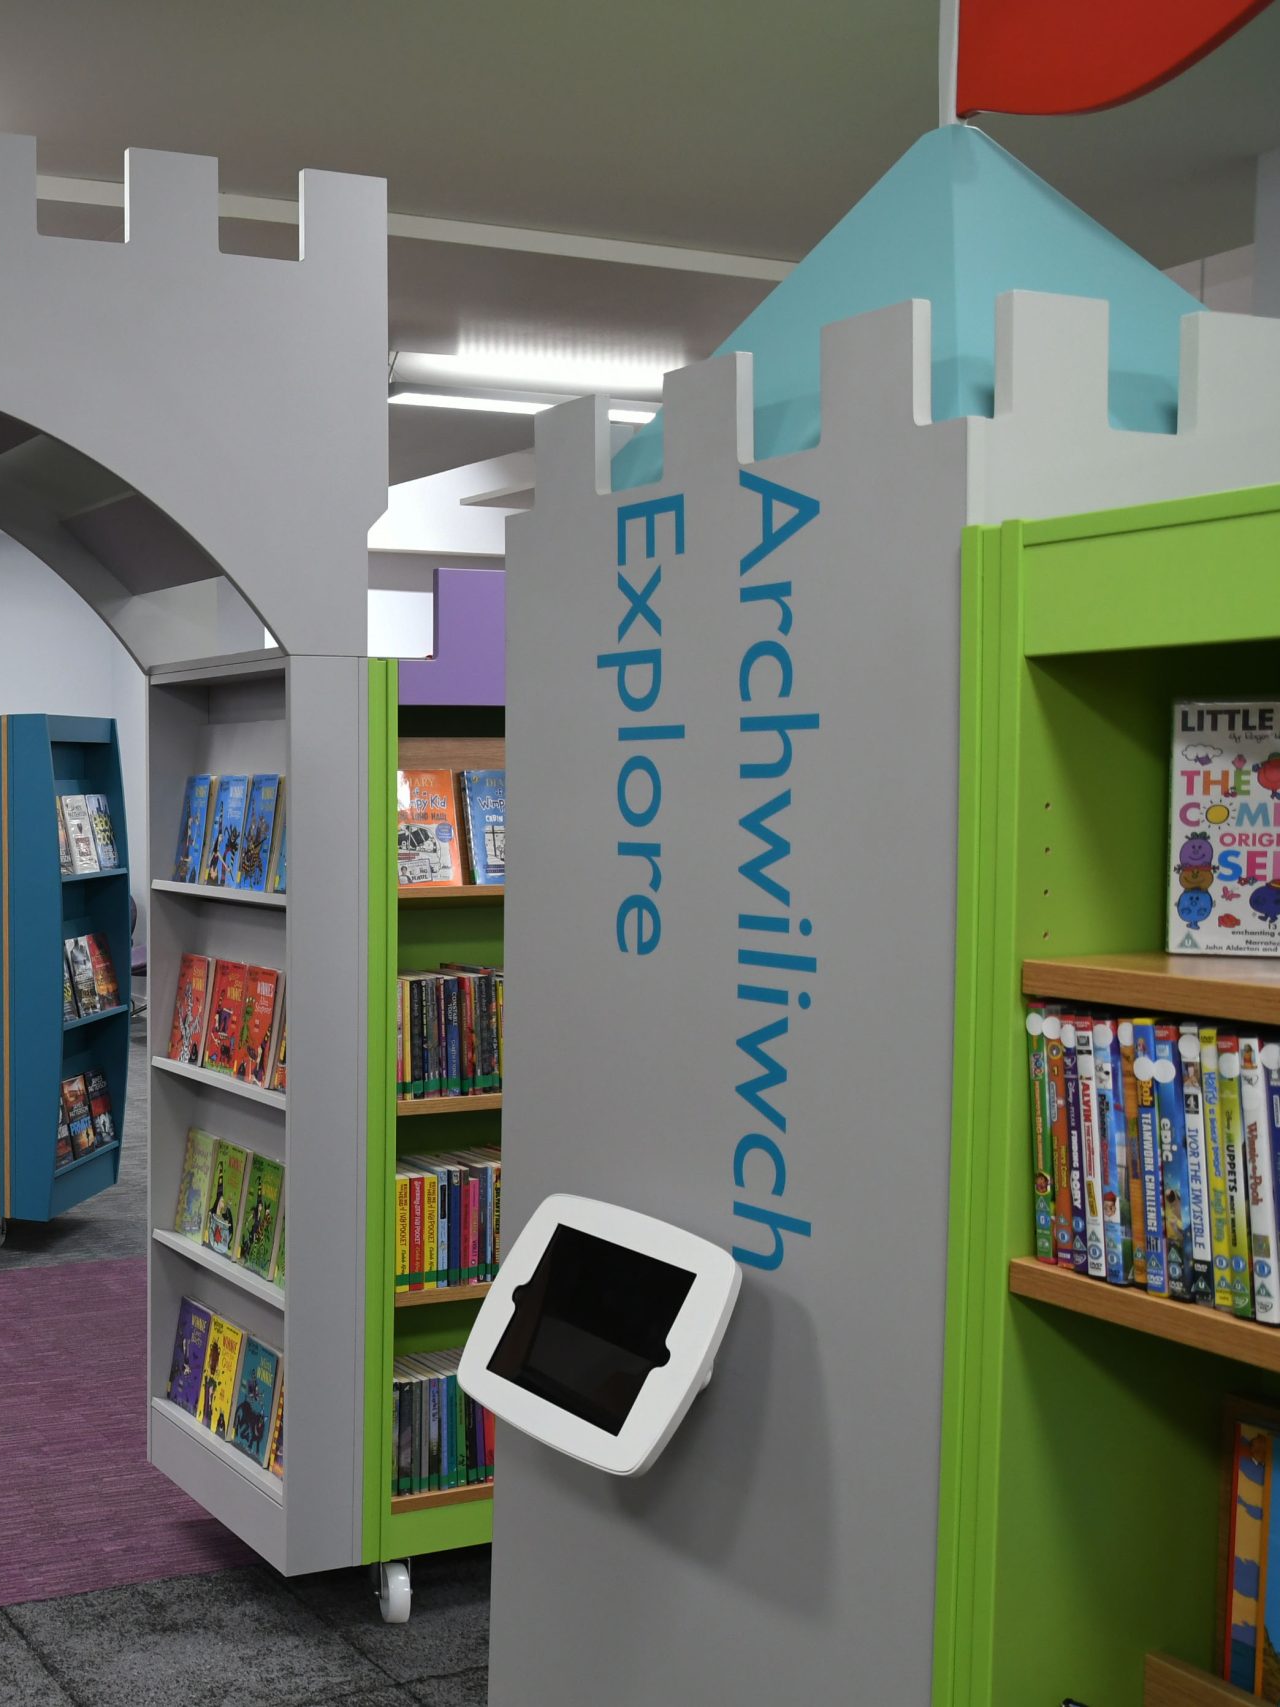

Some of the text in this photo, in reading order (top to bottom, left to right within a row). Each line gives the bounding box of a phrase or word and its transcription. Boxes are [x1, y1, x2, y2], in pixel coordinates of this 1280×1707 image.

[598, 495, 684, 954] Explore
[1181, 709, 1273, 731] LITTLE
[430, 795, 447, 808] Kid
[1181, 770, 1250, 795] THE
[733, 471, 820, 1270] Archwiliwch
[1079, 1082, 1092, 1123] ALVIN
[1141, 1080, 1152, 1106] Bob
[1203, 1072, 1216, 1105] Harry
[1159, 1118, 1178, 1162] epic
[1070, 1130, 1081, 1209] FINDING DORY
[1141, 1112, 1157, 1232] TEAMWORK CHALLENGE
[1187, 1128, 1206, 1250] IVOR THE INVISIBLE
